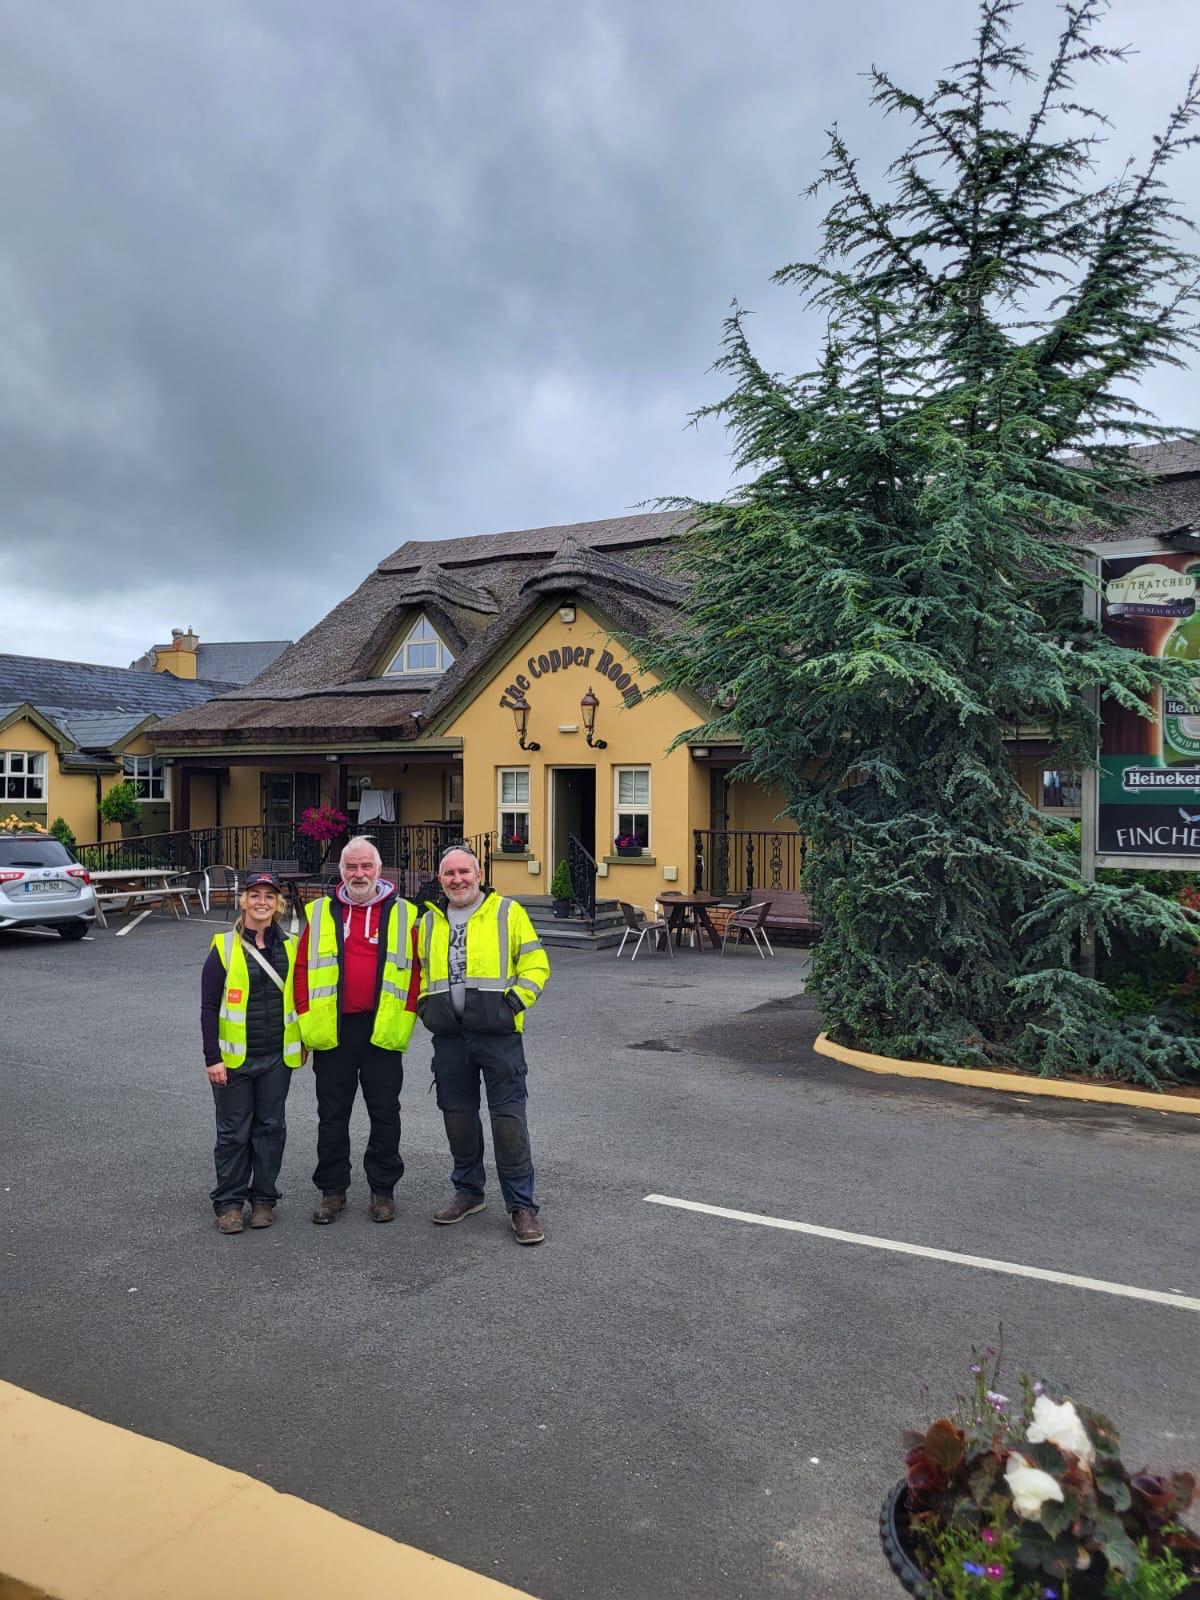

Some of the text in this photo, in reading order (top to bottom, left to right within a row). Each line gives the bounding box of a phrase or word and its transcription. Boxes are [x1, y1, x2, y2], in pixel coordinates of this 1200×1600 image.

[1110, 577, 1192, 590] THE THATCHED
[499, 645, 643, 710] The Copper Room
[1116, 826, 1200, 848] FINCHE
